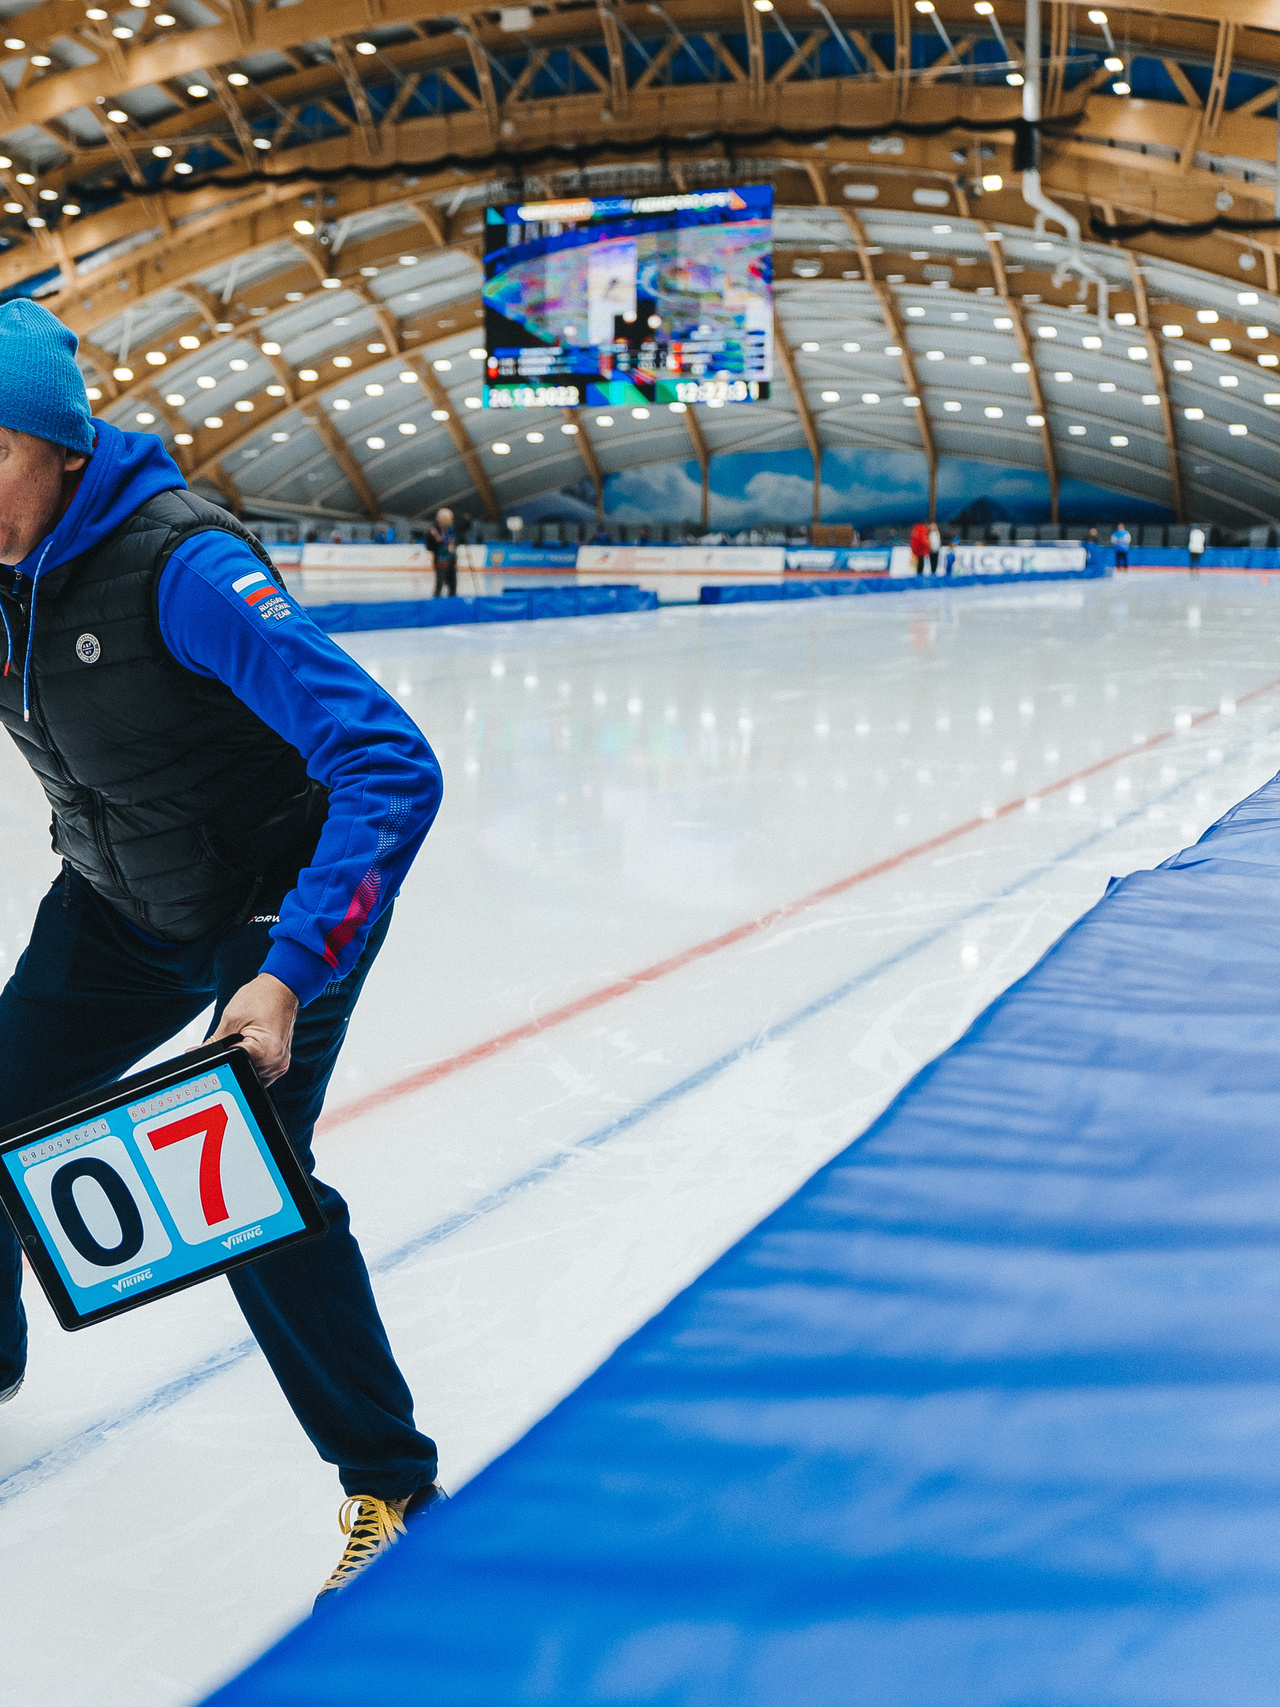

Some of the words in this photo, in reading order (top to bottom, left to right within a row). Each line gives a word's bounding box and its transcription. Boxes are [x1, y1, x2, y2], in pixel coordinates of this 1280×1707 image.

[258, 596, 285, 612] RUSSIAN
[261, 602, 291, 620] NATIONAL
[272, 609, 292, 620] TEAM
[221, 1225, 263, 1250] VIKING
[111, 1268, 153, 1293] VIKING
